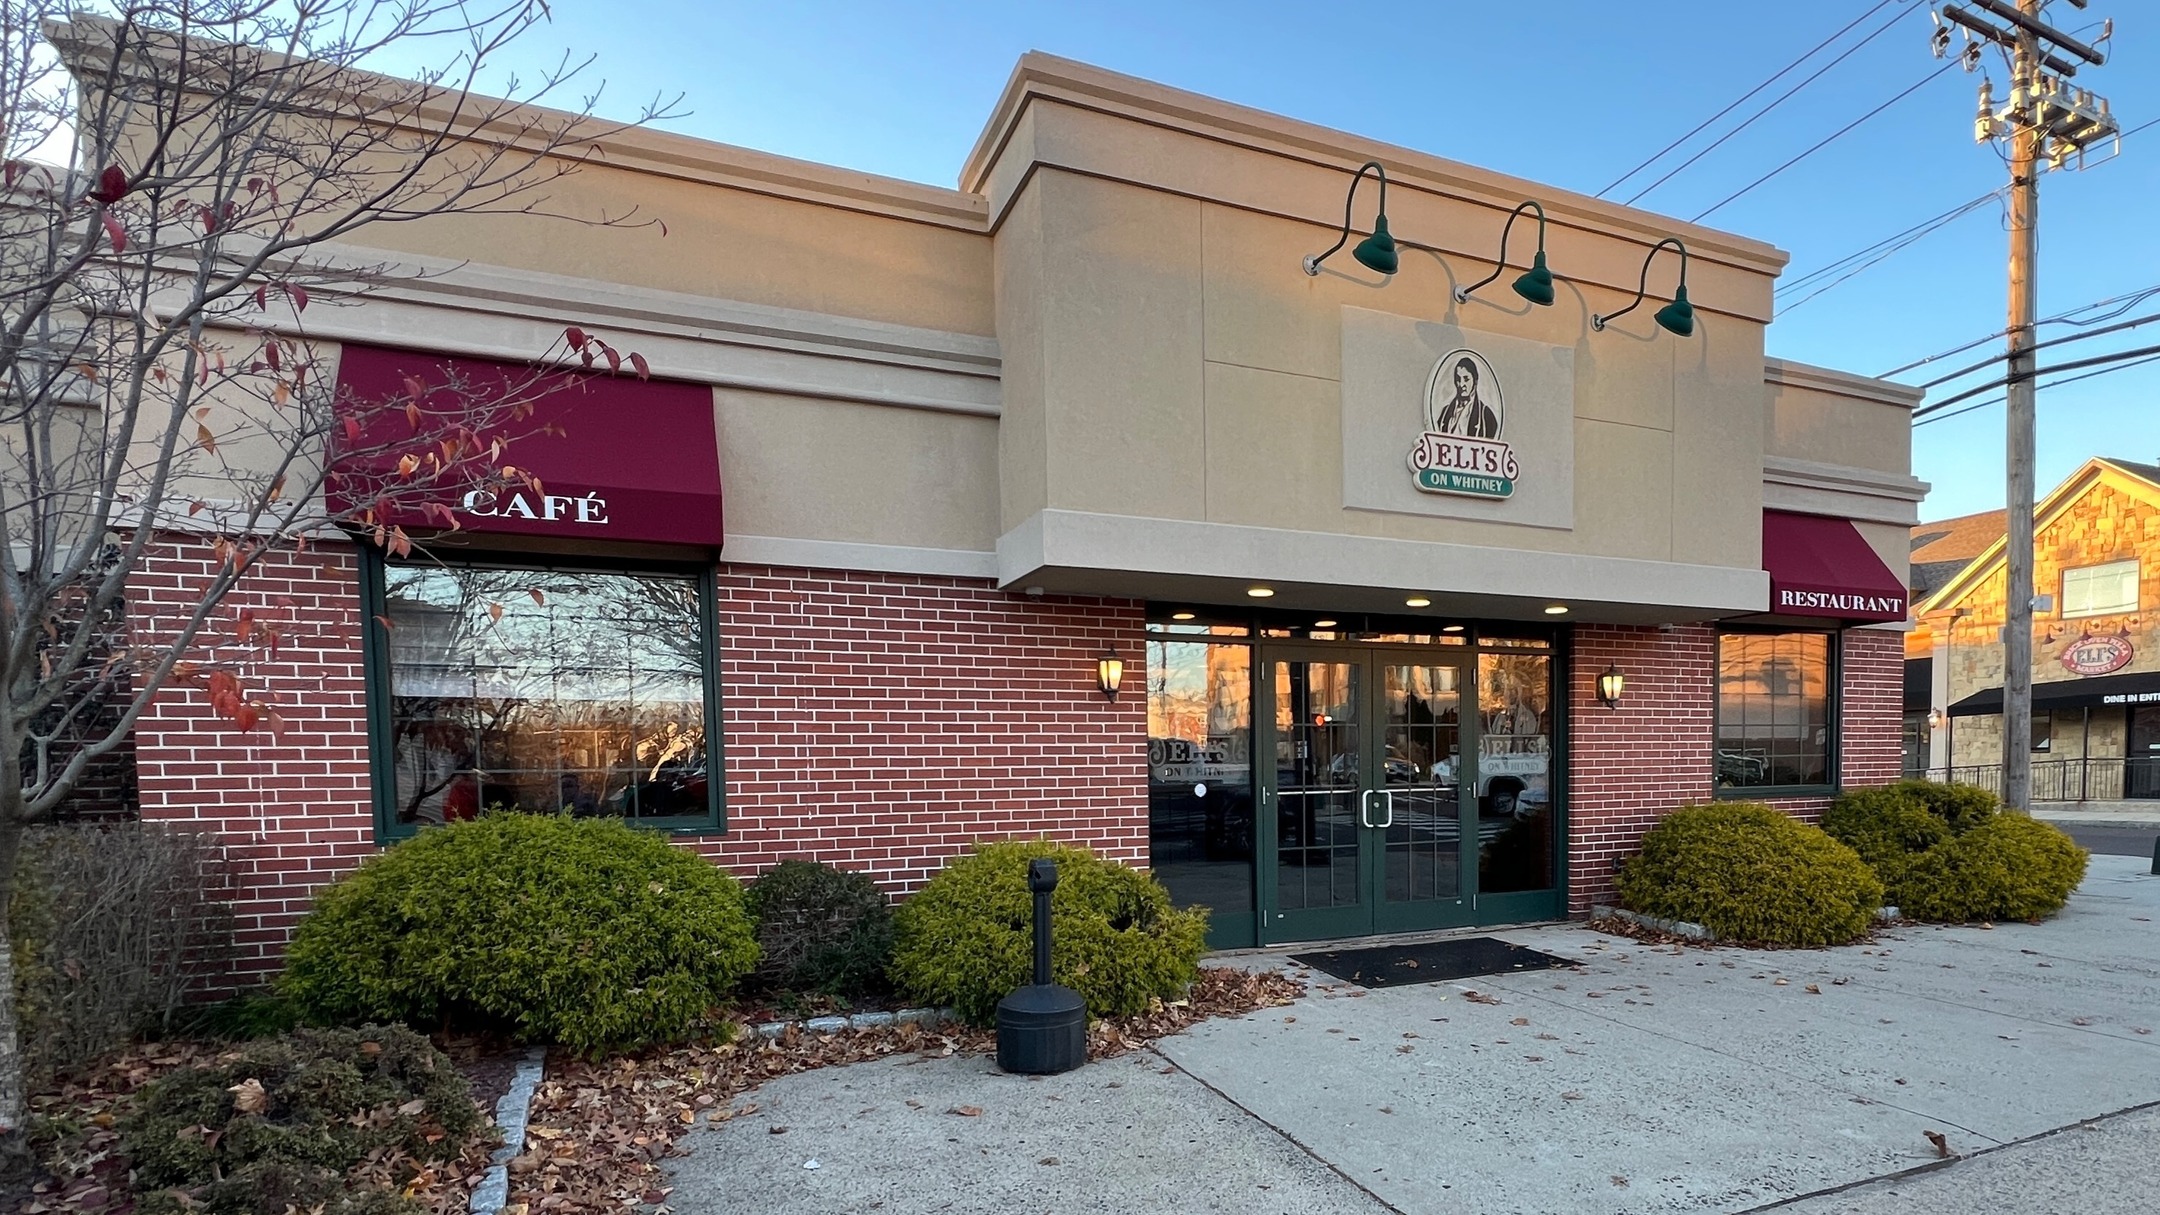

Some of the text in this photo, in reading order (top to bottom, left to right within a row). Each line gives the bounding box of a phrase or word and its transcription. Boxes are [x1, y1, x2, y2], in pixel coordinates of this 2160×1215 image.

[1435, 443, 1498, 473] ELI'S
[1430, 473, 1503, 492] ON WHITNEY
[463, 490, 608, 524] CAFÉ
[1781, 590, 1902, 613] RESTAURANT
[2077, 647, 2118, 663] ELI'S
[2109, 637, 2129, 656] PIZZA
[2076, 665, 2111, 673] MARKET
[2103, 695, 2126, 703] DINE
[2127, 694, 2138, 702] IN
